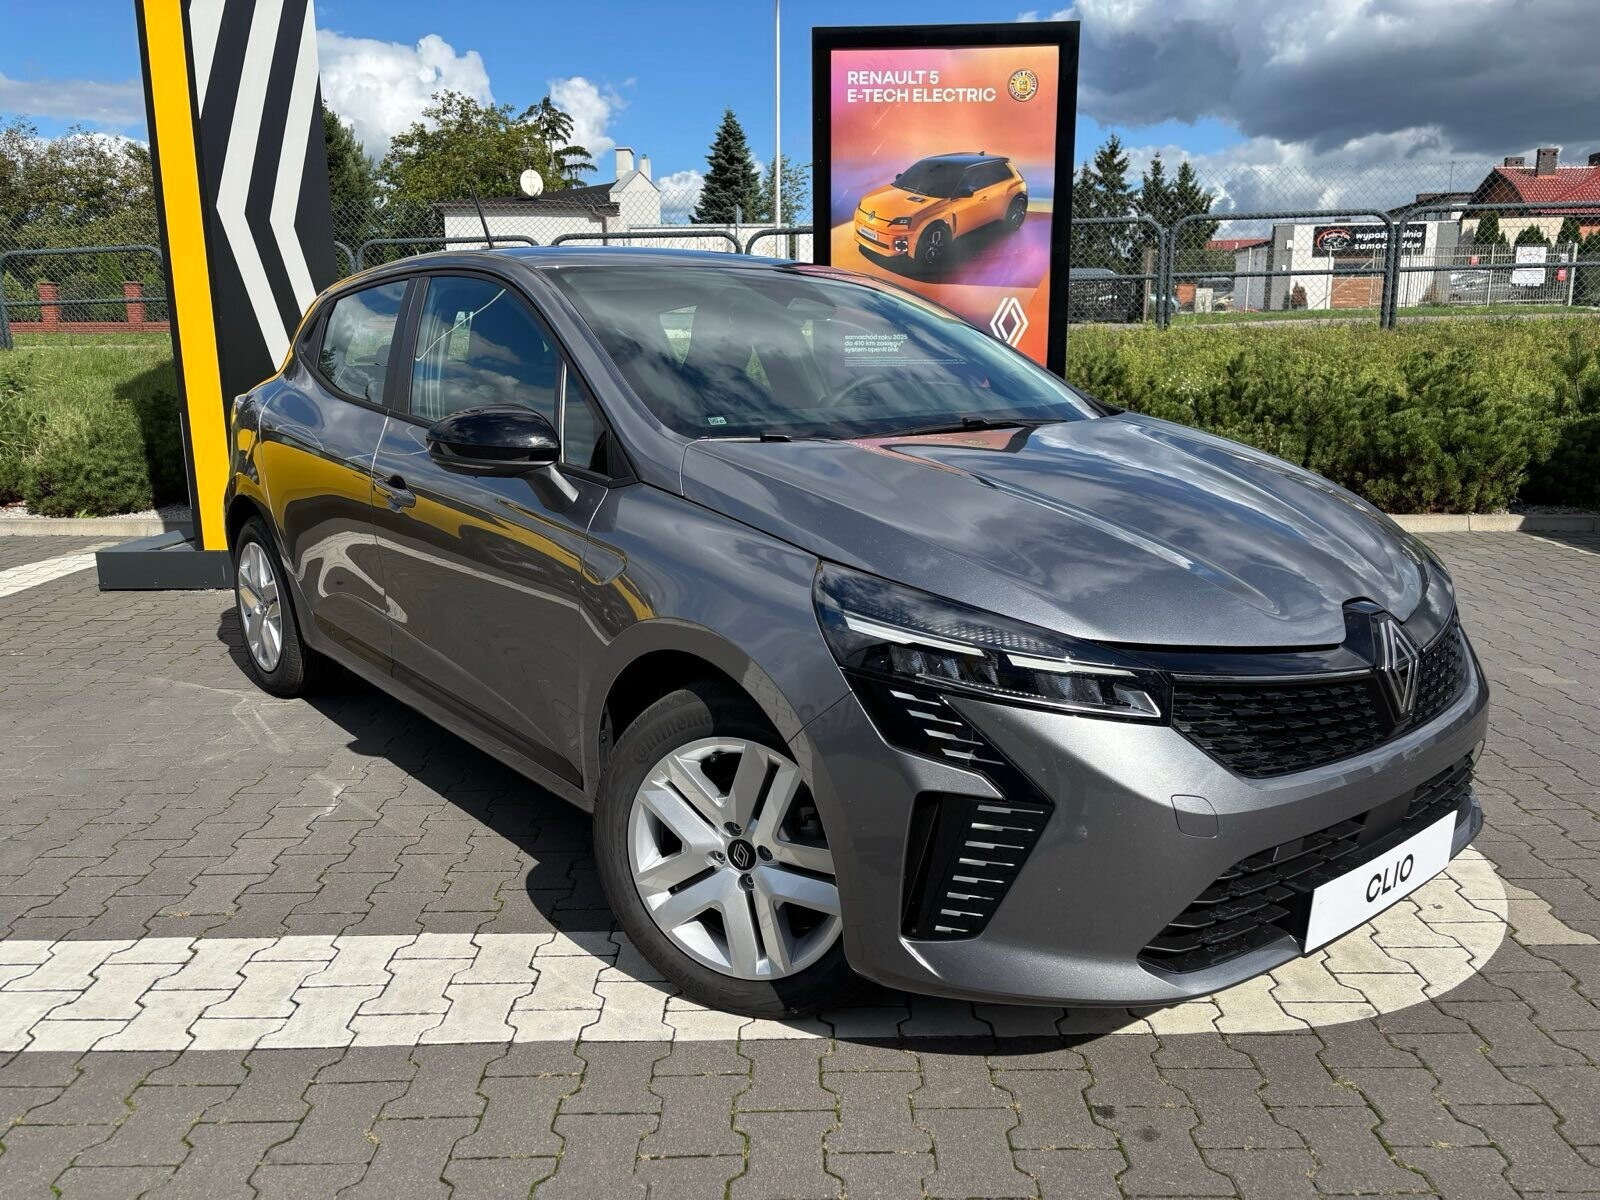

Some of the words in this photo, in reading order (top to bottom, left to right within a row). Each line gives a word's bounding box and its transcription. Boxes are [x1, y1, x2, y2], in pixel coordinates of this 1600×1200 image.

[848, 71, 926, 85] RENAULT
[929, 70, 939, 85] 5
[848, 88, 908, 103] E-TECH
[913, 87, 996, 103] ELECTRIC
[1366, 853, 1414, 903] CLIO
